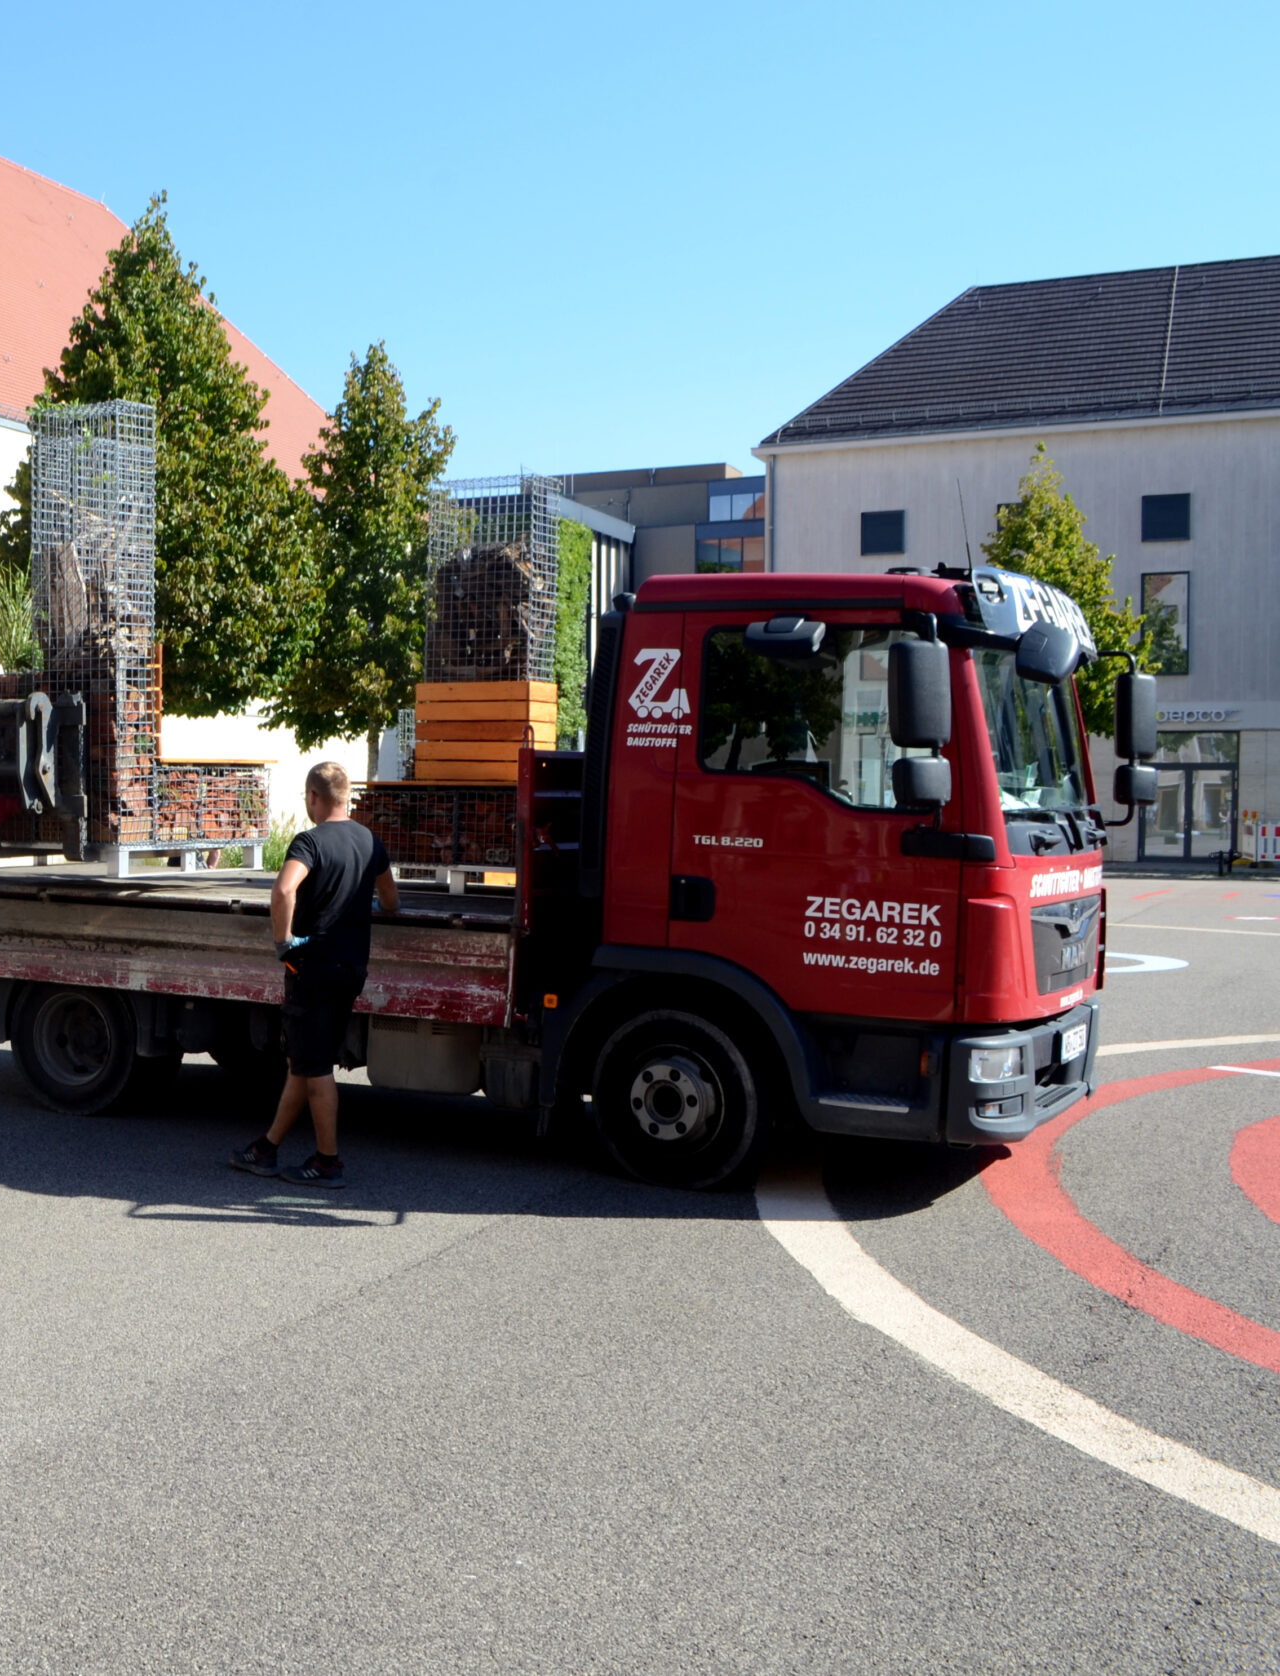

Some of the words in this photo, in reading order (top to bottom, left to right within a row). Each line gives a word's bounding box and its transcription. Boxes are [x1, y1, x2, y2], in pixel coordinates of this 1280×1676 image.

[998, 572, 1096, 653] ZEGARE
[635, 652, 673, 704] ZEGAREK
[627, 721, 692, 735] SCHÜTTGÜTER
[627, 737, 677, 748] BAUSTOFFE
[692, 834, 719, 846] TGL
[721, 836, 764, 848] 8.220
[804, 895, 942, 927] ZEGAREK
[804, 920, 816, 938] 0
[820, 921, 841, 940] 34
[876, 926, 898, 944] 62
[902, 928, 925, 947] 32
[929, 930, 942, 948] 0
[802, 951, 940, 976] www.zegarek.de
